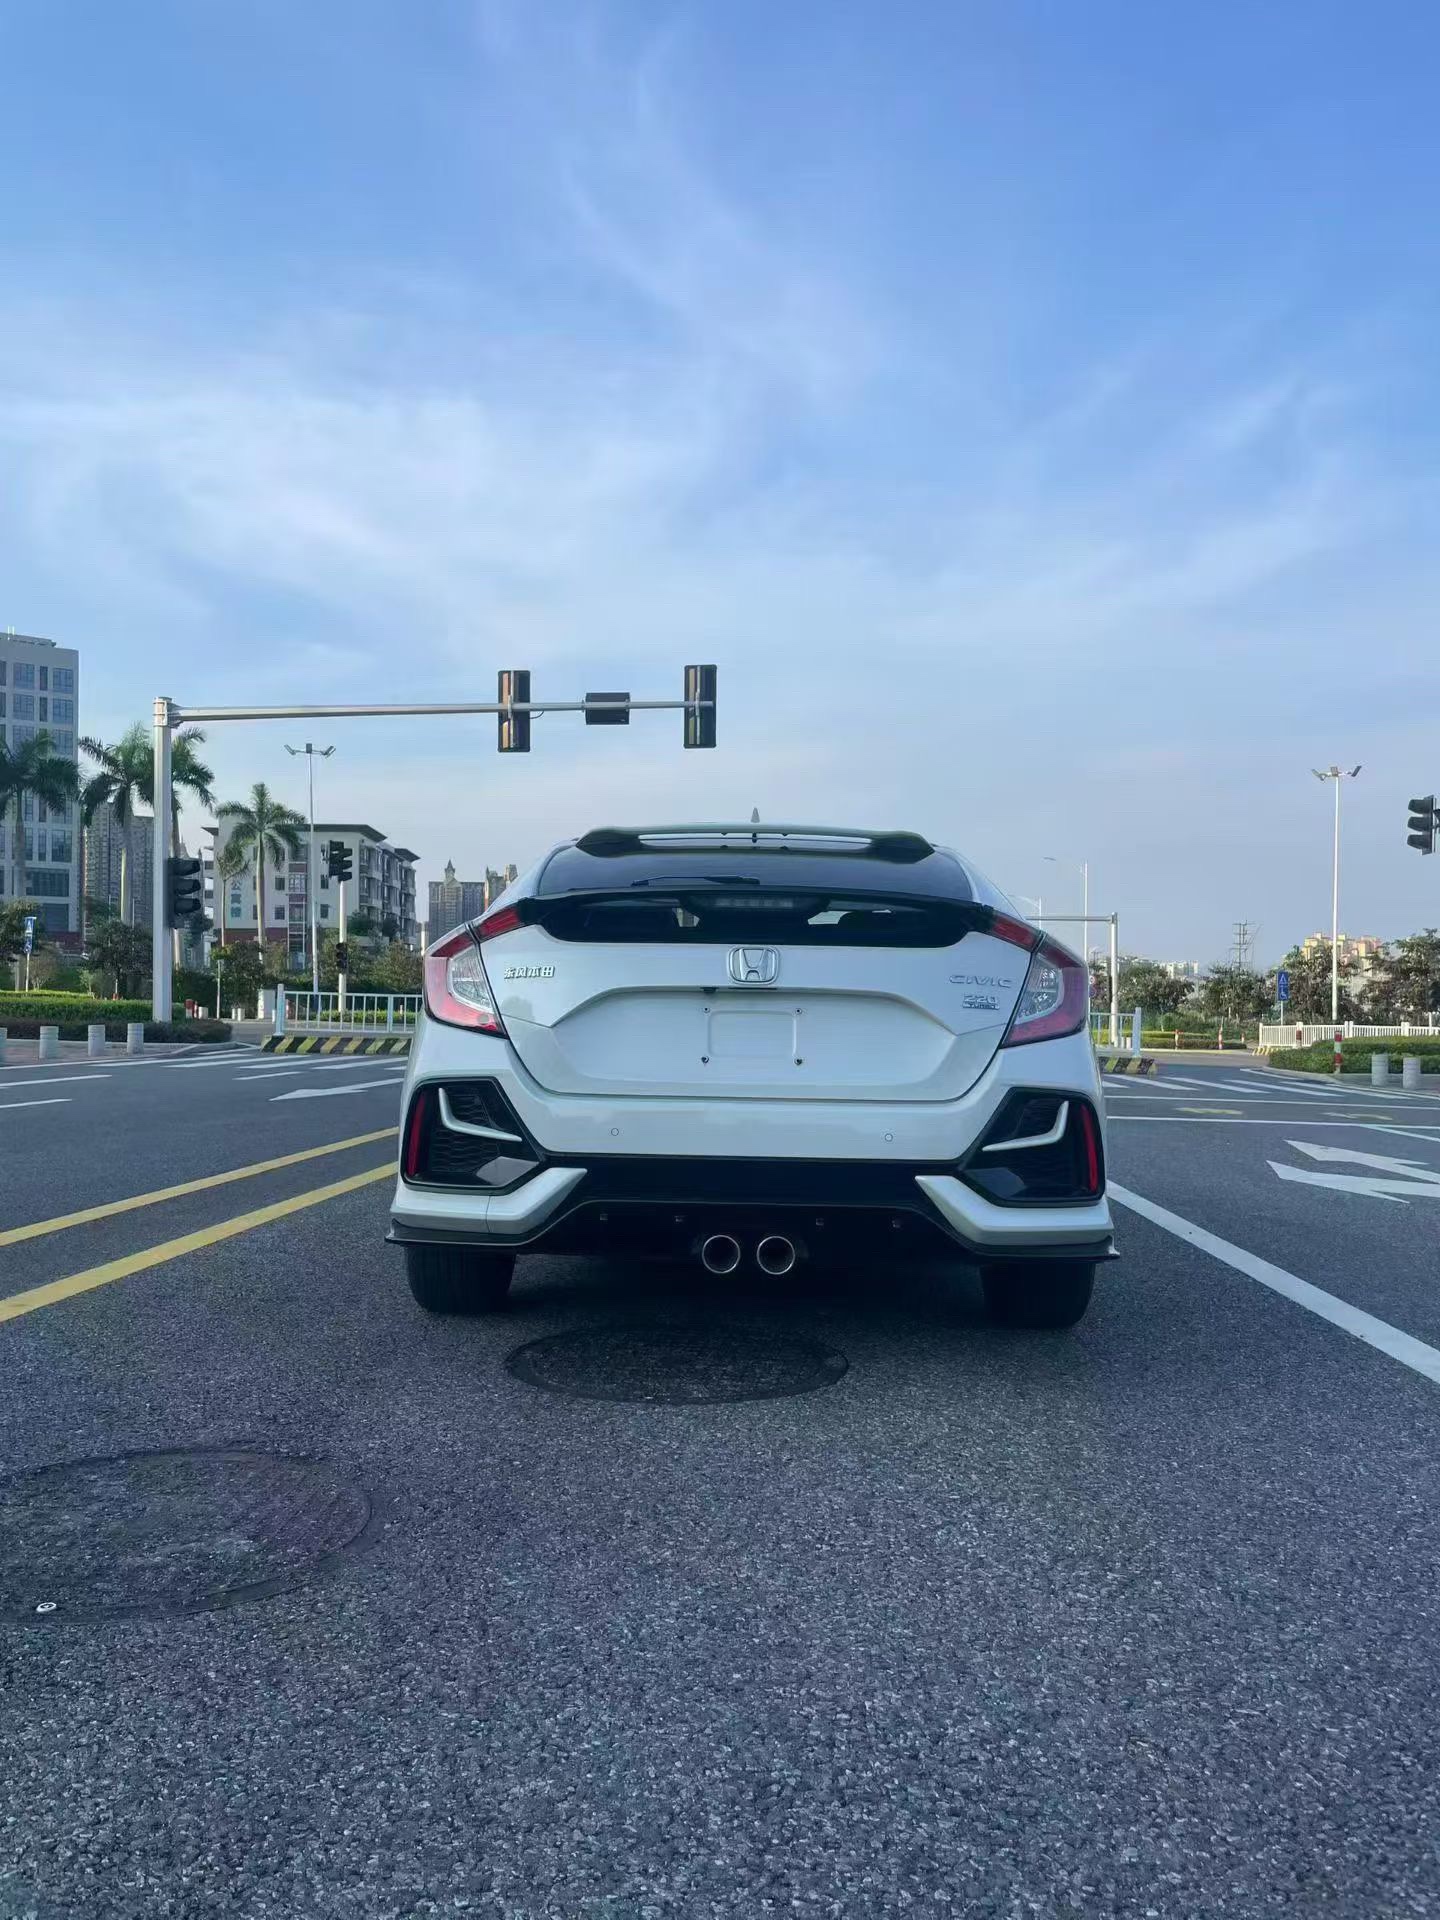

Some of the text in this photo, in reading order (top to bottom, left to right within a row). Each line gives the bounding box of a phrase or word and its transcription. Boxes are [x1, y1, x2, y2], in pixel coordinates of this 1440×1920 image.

[504, 965, 555, 979] 东风本田
[949, 975, 1012, 988] CIVIC
